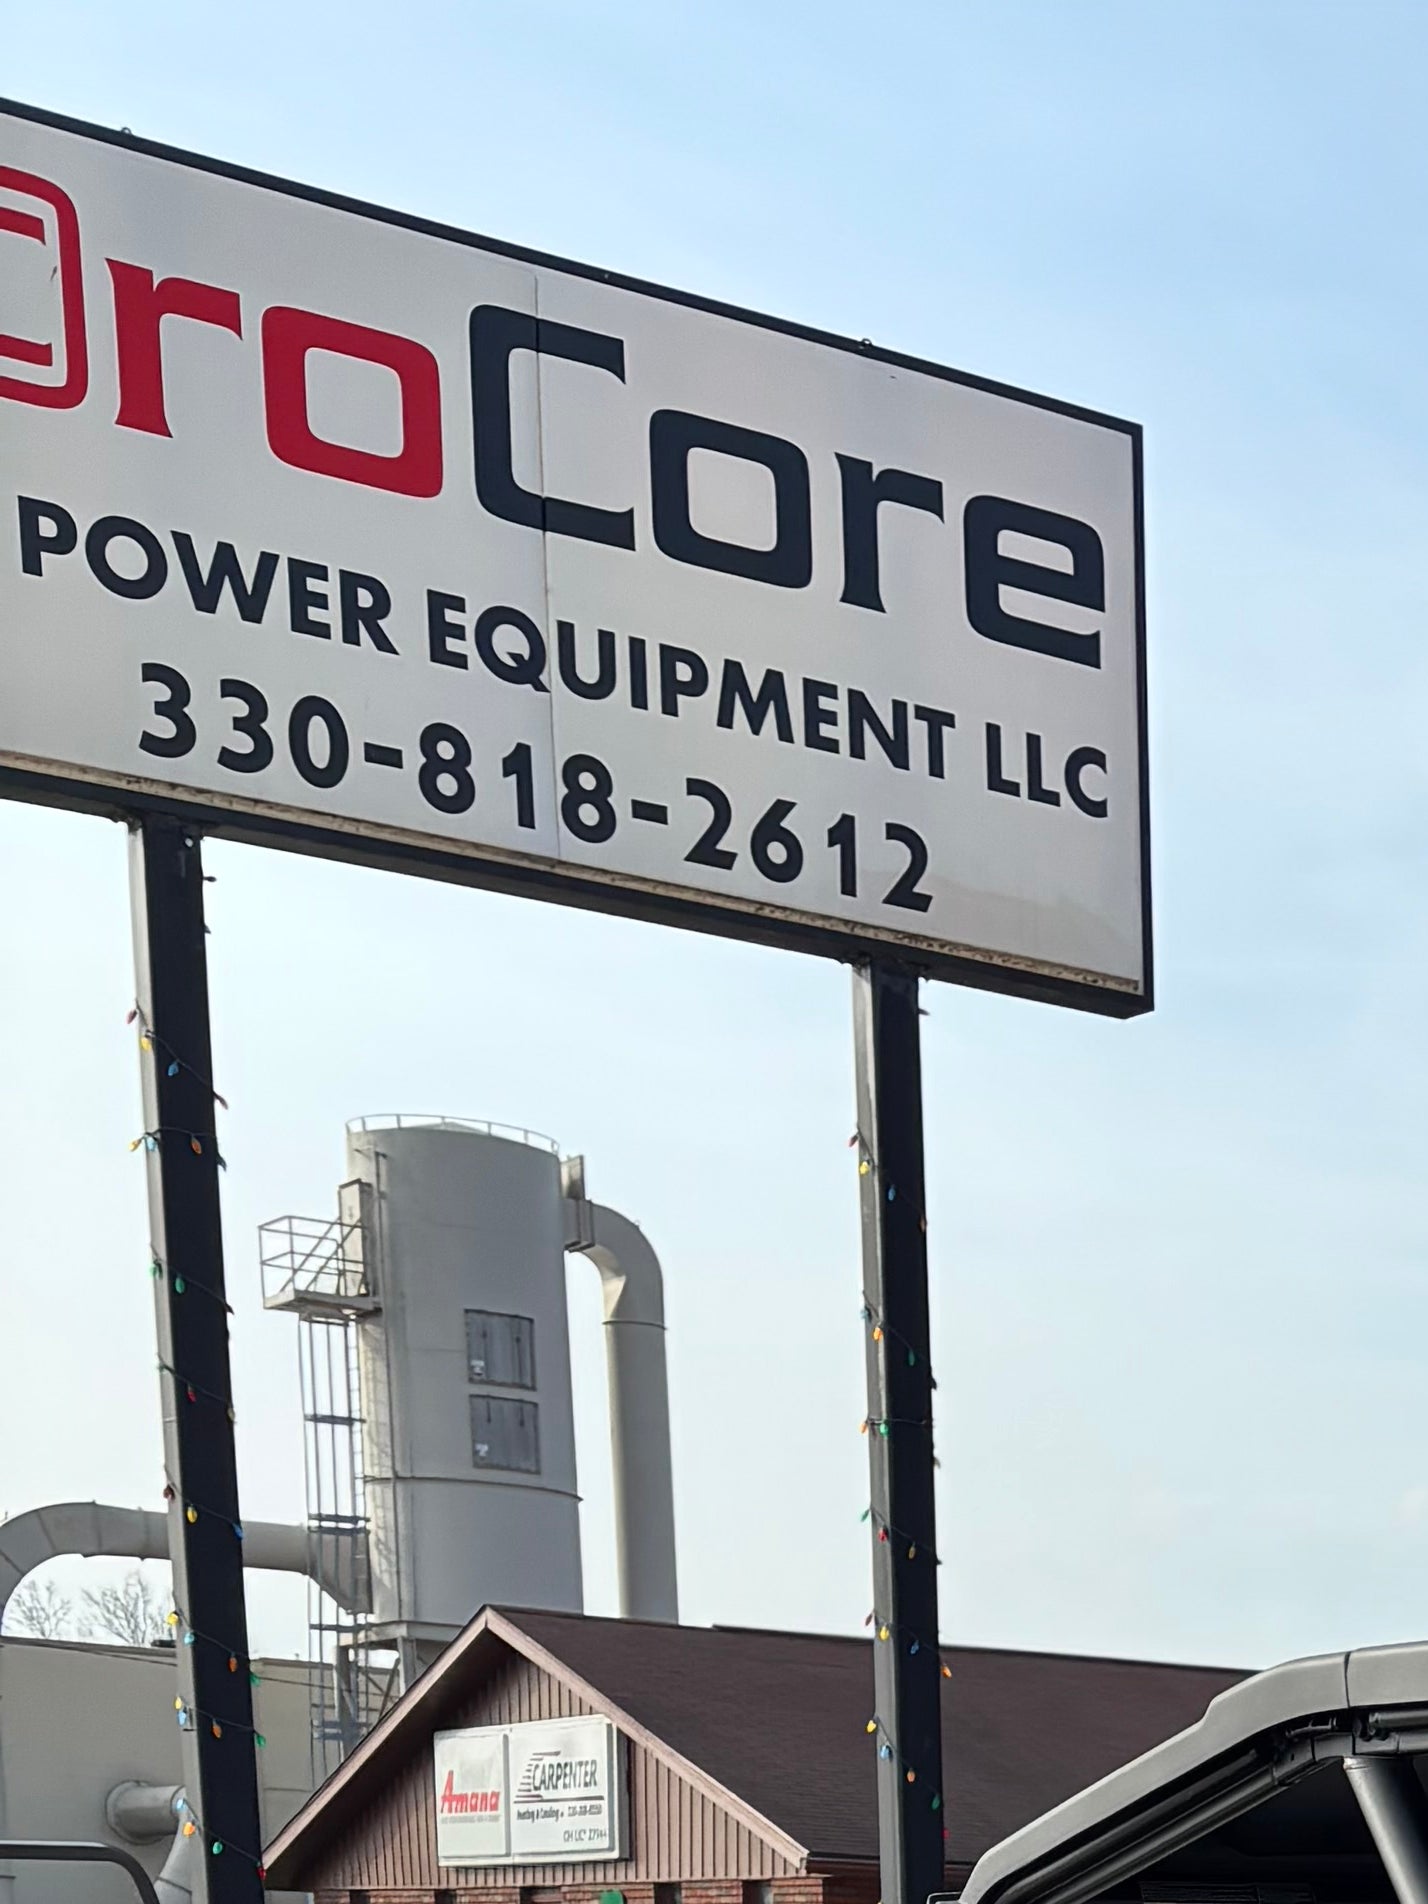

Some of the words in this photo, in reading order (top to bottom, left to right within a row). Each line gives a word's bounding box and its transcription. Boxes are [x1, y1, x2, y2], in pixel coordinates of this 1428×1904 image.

[18, 495, 399, 655] POWER
[427, 590, 956, 779] EQUIPMENT
[985, 721, 1109, 818] LLC
[138, 662, 934, 912] 330-818-2612
[440, 1770, 501, 1814] Amana
[532, 1760, 597, 1791] CARPENTER
